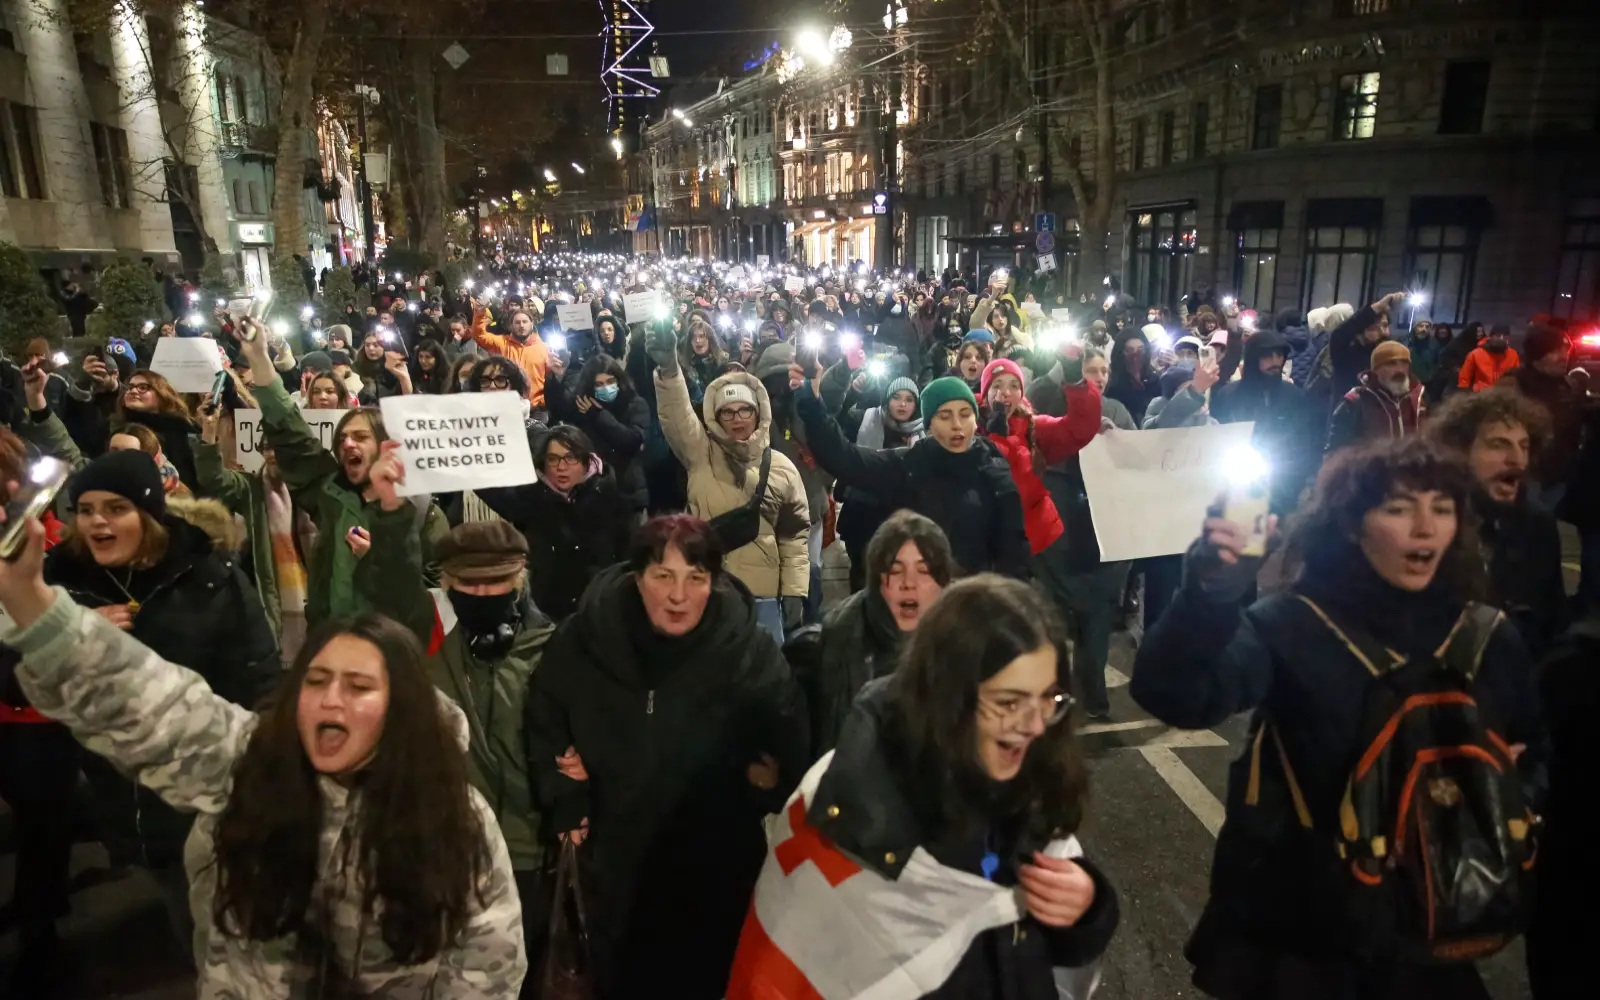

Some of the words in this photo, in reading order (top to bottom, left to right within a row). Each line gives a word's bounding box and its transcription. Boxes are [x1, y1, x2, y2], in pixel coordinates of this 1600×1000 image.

[405, 416, 500, 431] CREATIVITY
[404, 437, 445, 451] WILL
[449, 435, 481, 448] NOT
[487, 434, 507, 446] BE
[415, 453, 505, 469] CENSORED
